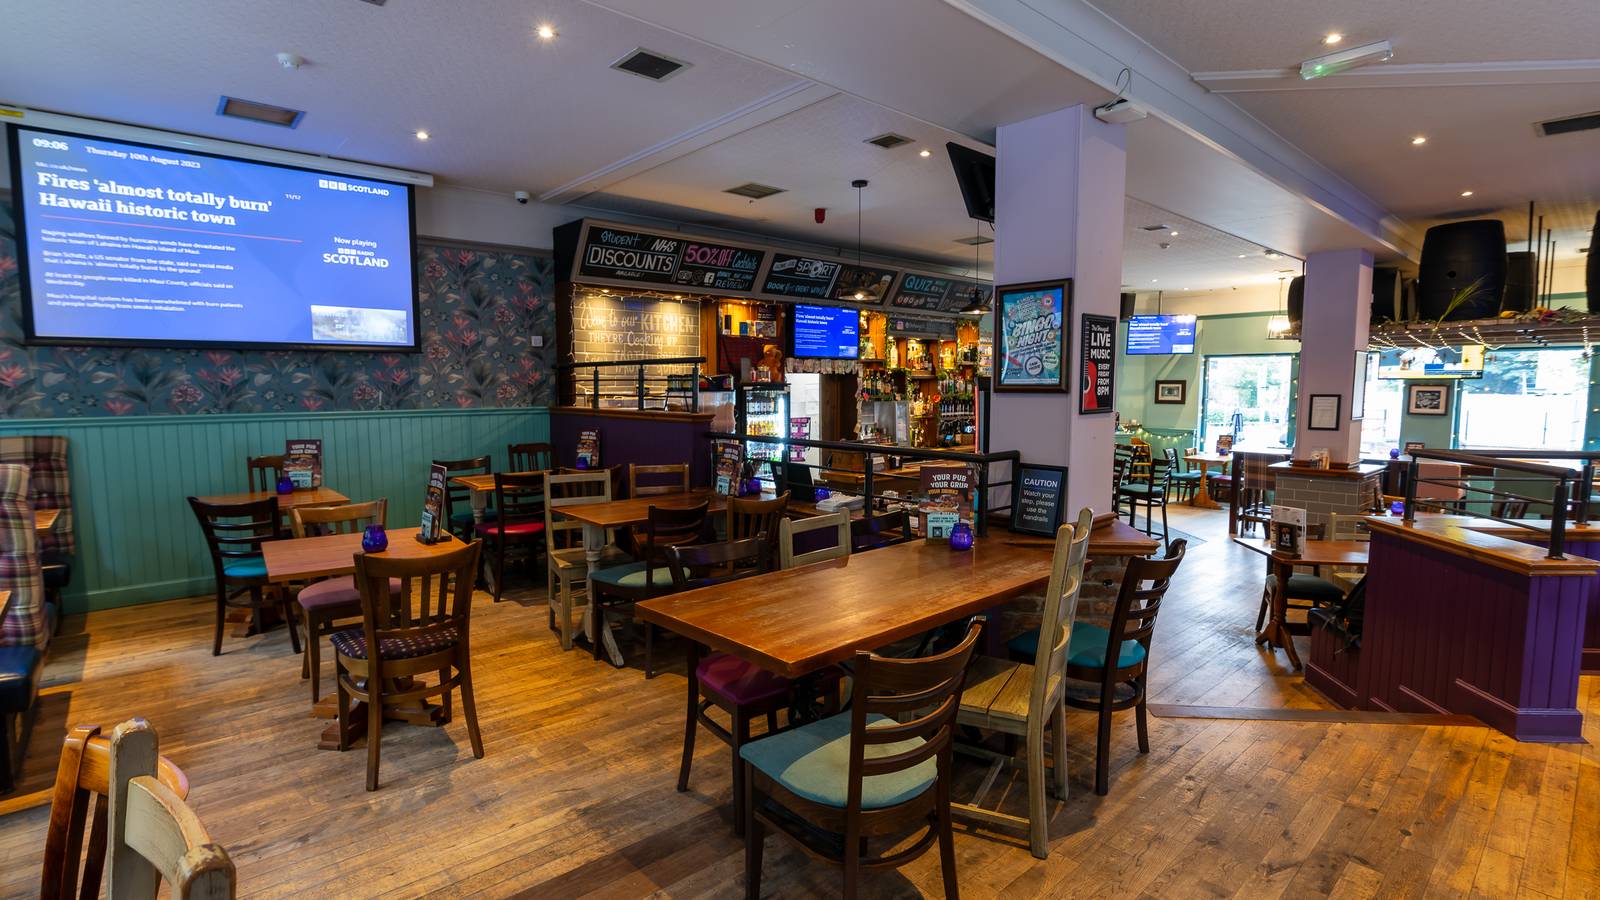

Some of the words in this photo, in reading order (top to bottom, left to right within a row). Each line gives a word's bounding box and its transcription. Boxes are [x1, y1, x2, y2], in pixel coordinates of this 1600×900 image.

[32, 138, 69, 150] 09:06
[85, 146, 127, 159] Thursday
[129, 152, 148, 161] 10th
[150, 155, 178, 166] August
[180, 160, 200, 168] 2023
[36, 171, 90, 190] Fires
[92, 178, 164, 199] 'almost
[166, 188, 226, 209] totally
[228, 195, 272, 212] burn'
[347, 184, 389, 196] SCOTLAND
[38, 191, 112, 212] Hawaii
[115, 200, 188, 220] historic
[190, 209, 236, 225] town
[351, 239, 377, 248] playing
[650, 238, 678, 252] NHS
[323, 253, 388, 267] SCOTLAND
[590, 246, 674, 272] DISCOUNTS
[686, 244, 719, 265] 50%
[718, 249, 735, 267] OFF
[796, 260, 836, 277] SPORT
[905, 276, 932, 292] QUIZ
[641, 313, 694, 333] KITCHEN
[1013, 315, 1053, 336] BINGO
[1017, 330, 1049, 348] NIGHT
[1091, 332, 1110, 347] LIVE
[1090, 348, 1110, 360] MUSIC
[1097, 386, 1109, 396] 8PM
[1024, 478, 1058, 488] CAUTION
